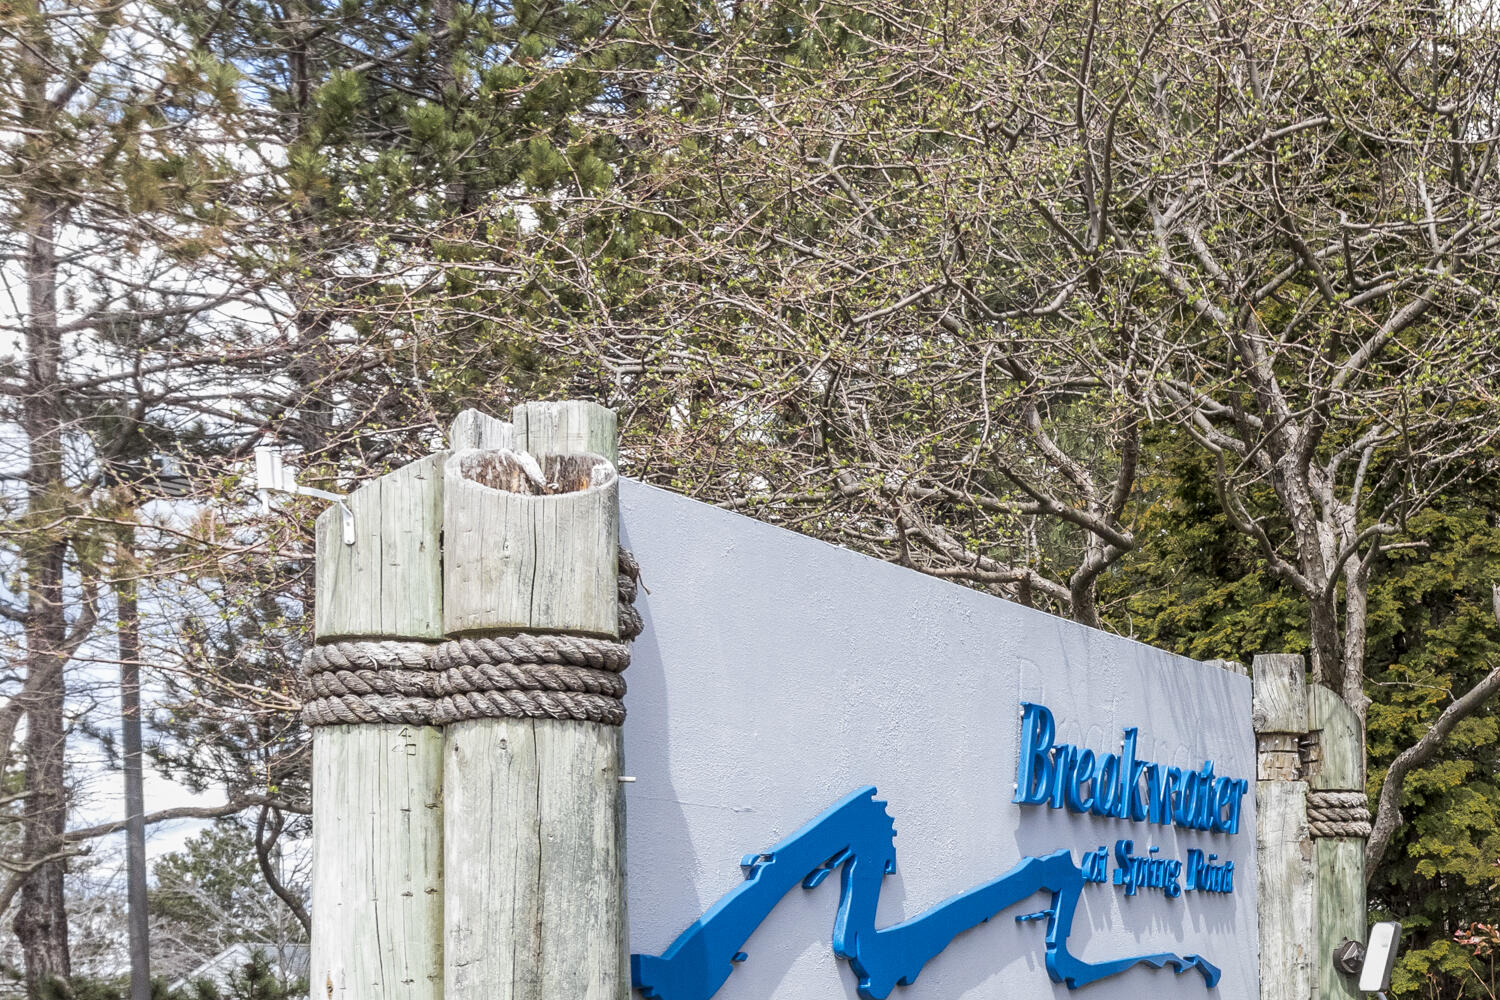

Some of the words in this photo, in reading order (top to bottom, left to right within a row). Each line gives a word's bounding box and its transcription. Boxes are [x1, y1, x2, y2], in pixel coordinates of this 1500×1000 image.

[1011, 702, 1248, 834] Breakwater
[1082, 846, 1109, 883] at
[1113, 840, 1182, 898] Spring
[1185, 848, 1235, 893] Point
